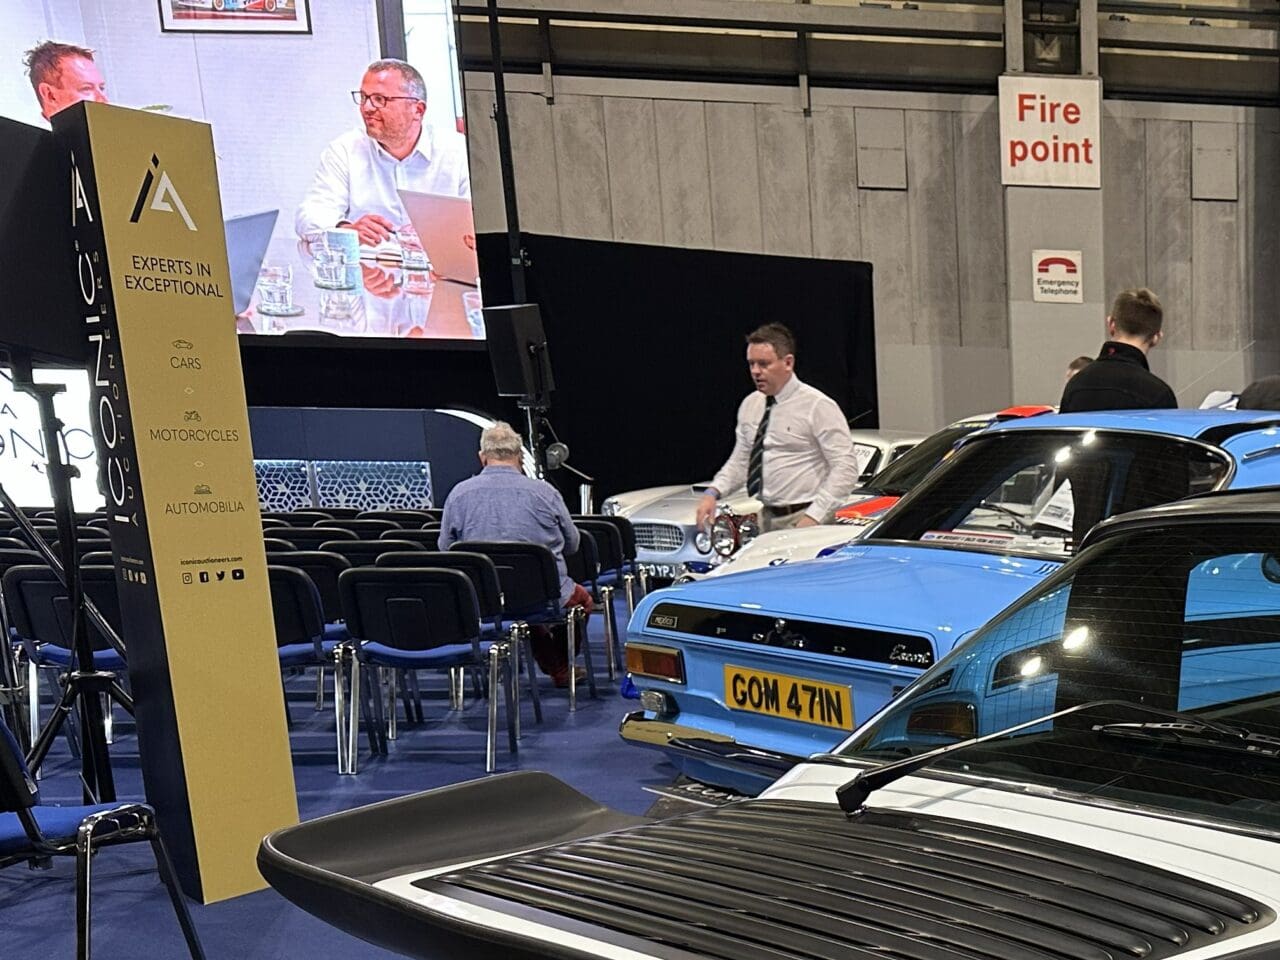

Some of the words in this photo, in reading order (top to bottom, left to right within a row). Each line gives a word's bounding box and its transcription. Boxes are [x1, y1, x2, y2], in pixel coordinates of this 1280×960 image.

[1017, 93, 1081, 124] Fire
[1009, 134, 1094, 167] point
[132, 255, 193, 276] EXPERTS
[196, 262, 212, 278] IN
[124, 275, 224, 298] EXCEPTIONAL
[1036, 277, 1080, 289] Emergency
[1039, 286, 1079, 296] Telephone
[170, 356, 202, 370] CARS
[78, 252, 130, 523] ICONIC
[93, 251, 139, 528] AUCTIONEERS
[149, 428, 240, 443] MOTORCYCLES
[164, 500, 246, 515] AUTOMOBILIA
[179, 555, 243, 567] iconicauctioneers.com
[656, 564, 677, 578] YPJ
[889, 643, 931, 665] Escort
[732, 672, 782, 714] GOM
